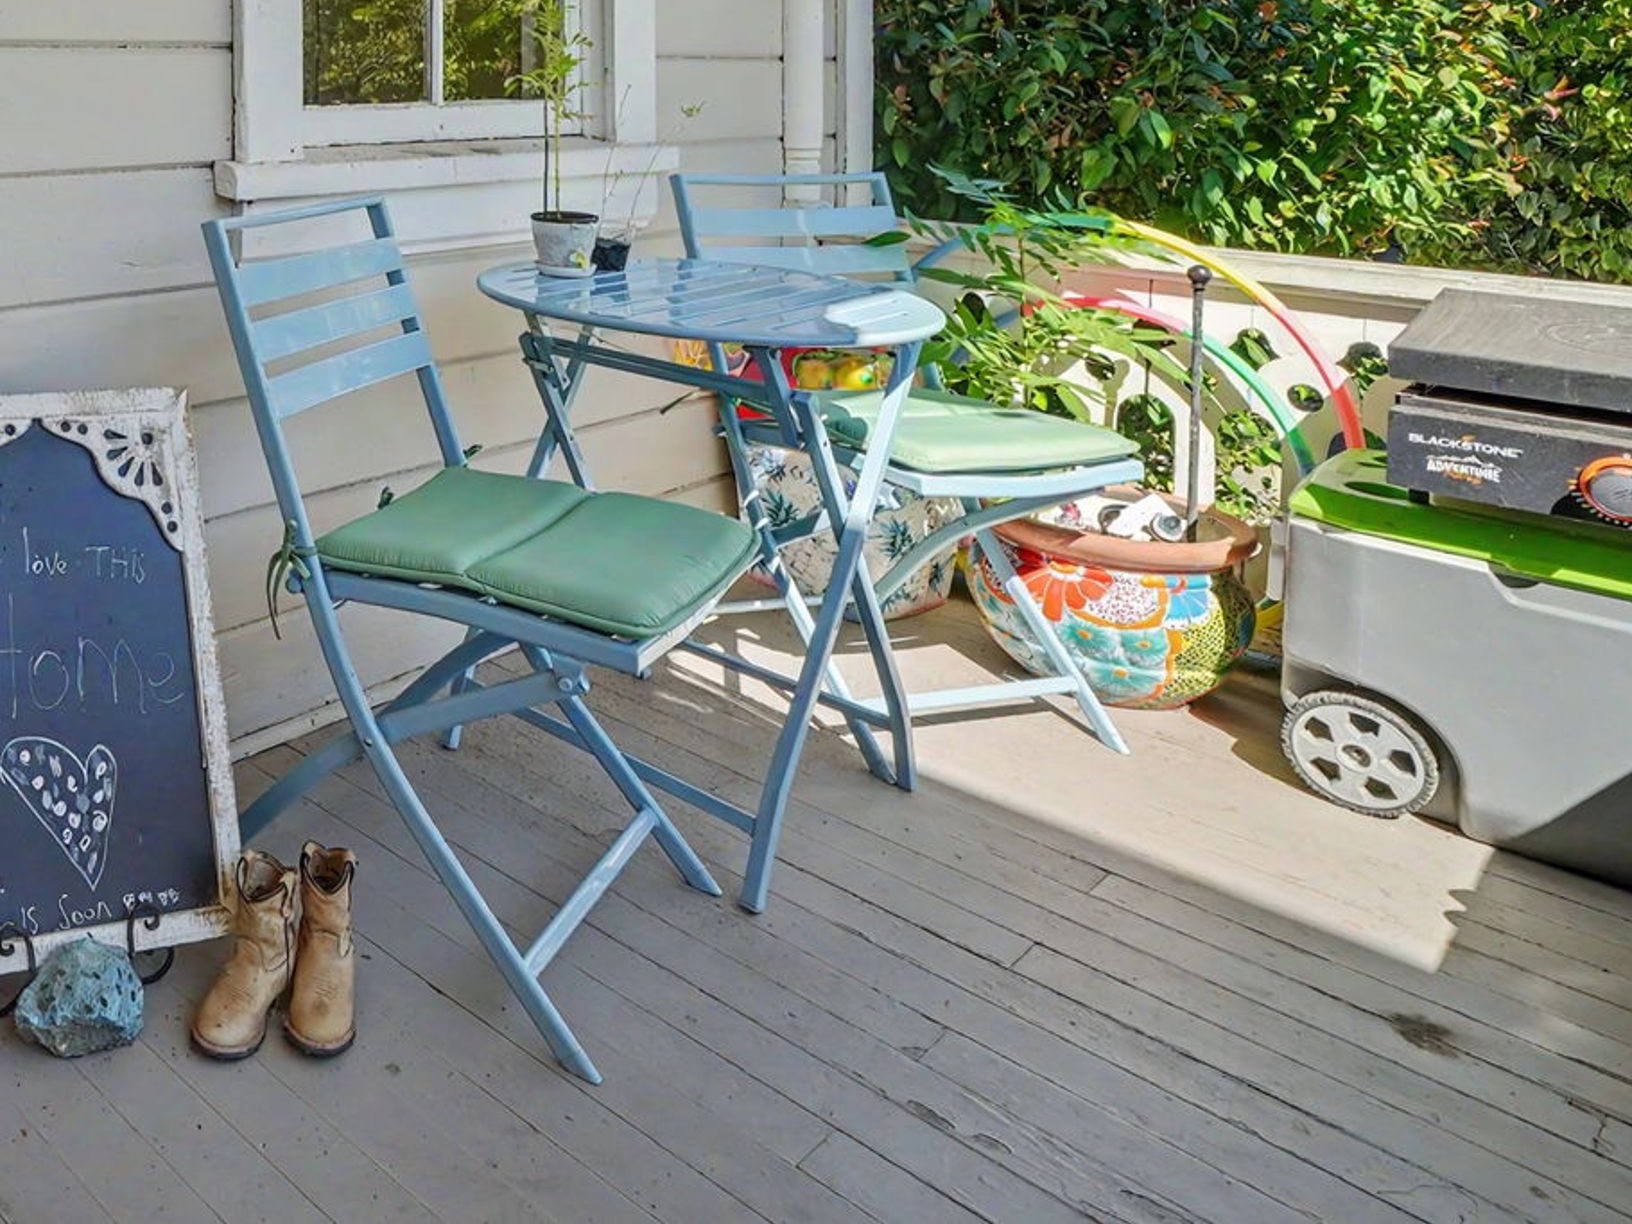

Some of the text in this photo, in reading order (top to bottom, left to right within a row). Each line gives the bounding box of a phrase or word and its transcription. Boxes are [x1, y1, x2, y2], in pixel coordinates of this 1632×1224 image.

[1408, 432, 1524, 458] BLACKSTONE
[1426, 458, 1502, 483] ADVENTURE
[22, 526, 68, 575] love
